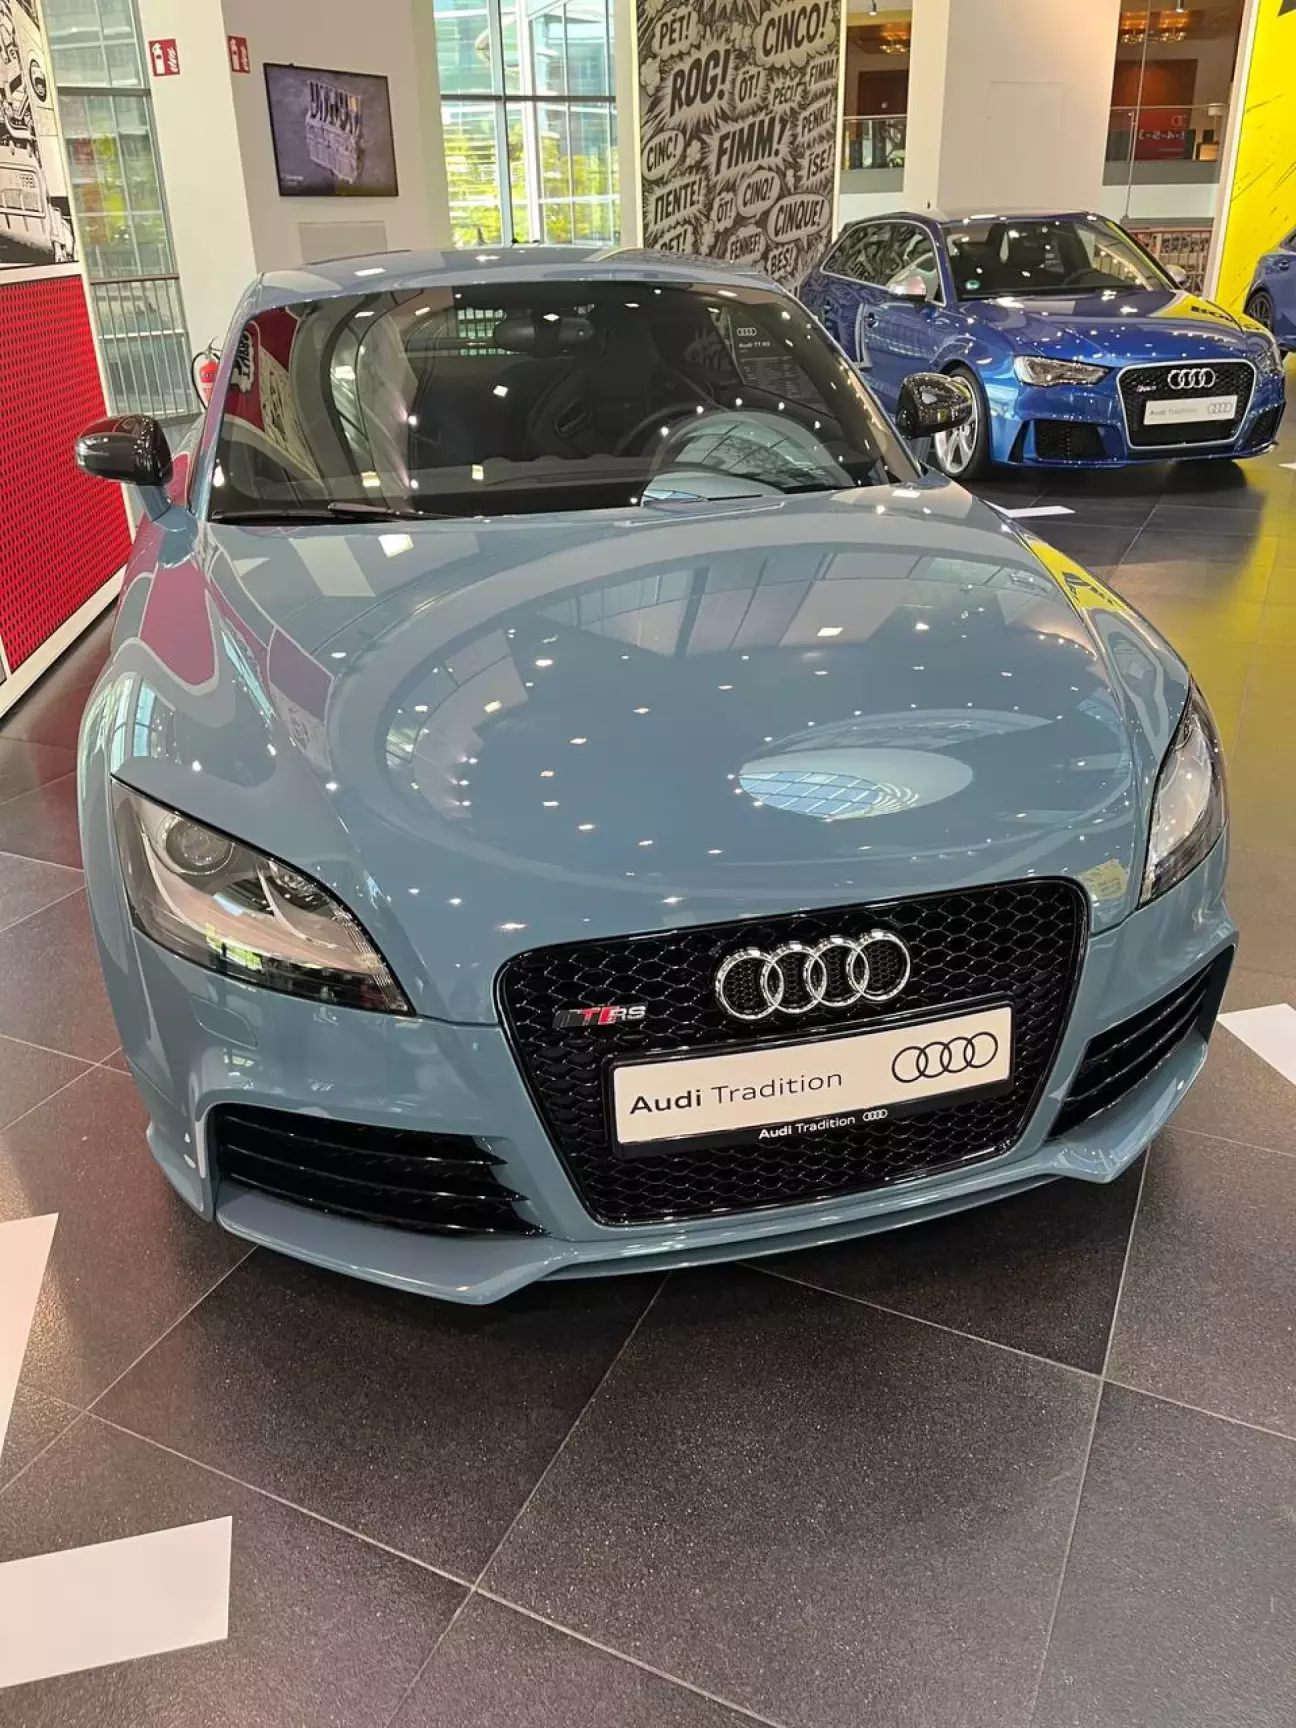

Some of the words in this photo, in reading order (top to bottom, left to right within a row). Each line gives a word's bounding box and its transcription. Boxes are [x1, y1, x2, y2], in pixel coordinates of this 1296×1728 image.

[762, 1, 831, 57] CINCO!
[669, 49, 733, 117] ROG!
[738, 70, 761, 103] ÖT!
[808, 57, 839, 87] FIMM!
[646, 133, 679, 172] CINC!
[713, 114, 789, 177] FIMM!
[742, 176, 775, 209] CINQ!
[774, 200, 825, 238] CINQUE!
[629, 1088, 702, 1114] Audi
[711, 1071, 843, 1104] Tradition
[758, 1123, 792, 1139] Audi
[795, 1114, 856, 1135] Tradition
